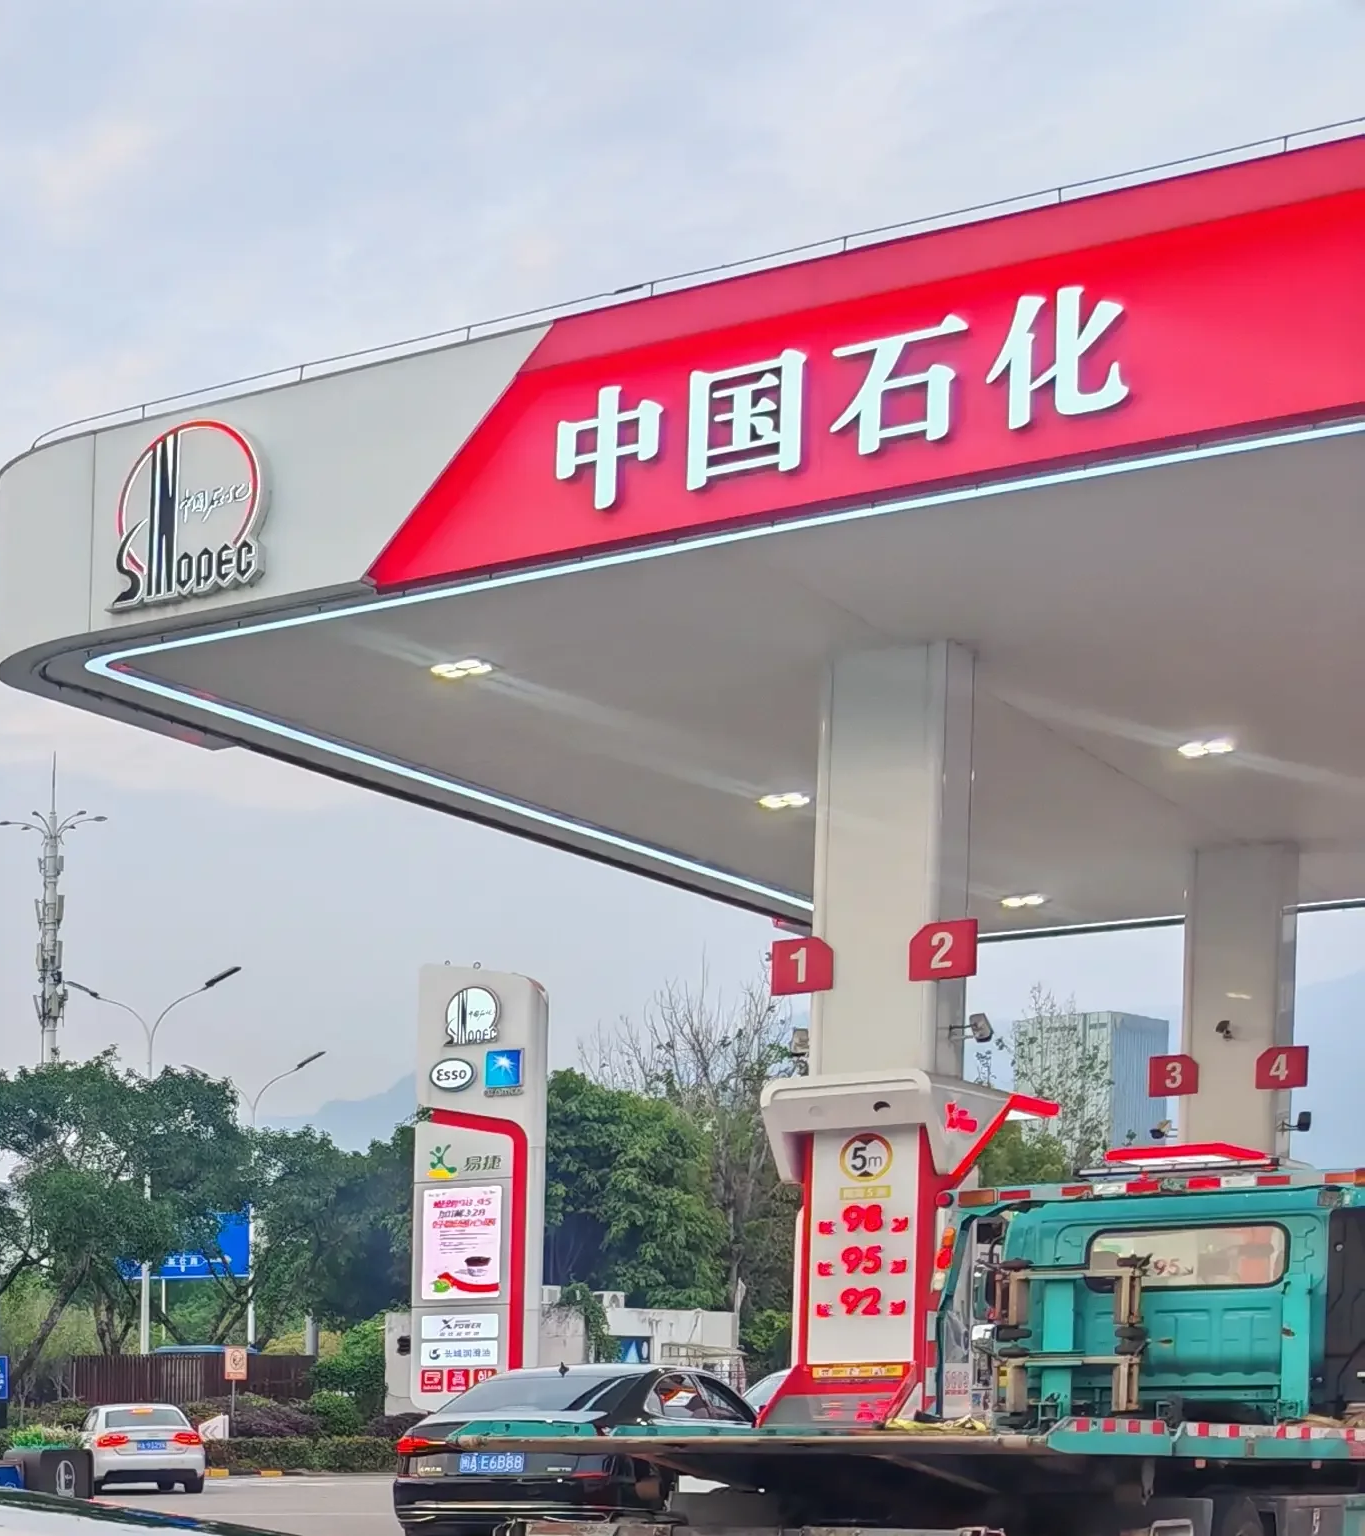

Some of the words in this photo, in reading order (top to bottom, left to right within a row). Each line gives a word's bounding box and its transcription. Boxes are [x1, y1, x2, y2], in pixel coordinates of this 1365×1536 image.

[556, 285, 1131, 510] 中国石化
[929, 930, 954, 970] 2
[789, 947, 807, 984] 1
[1165, 1061, 1183, 1089] 3
[1269, 1053, 1289, 1082] 4
[463, 1155, 502, 1172] 易捷
[841, 1203, 884, 1233] 98
[840, 1244, 883, 1275] 95
[839, 1286, 882, 1316] 92
